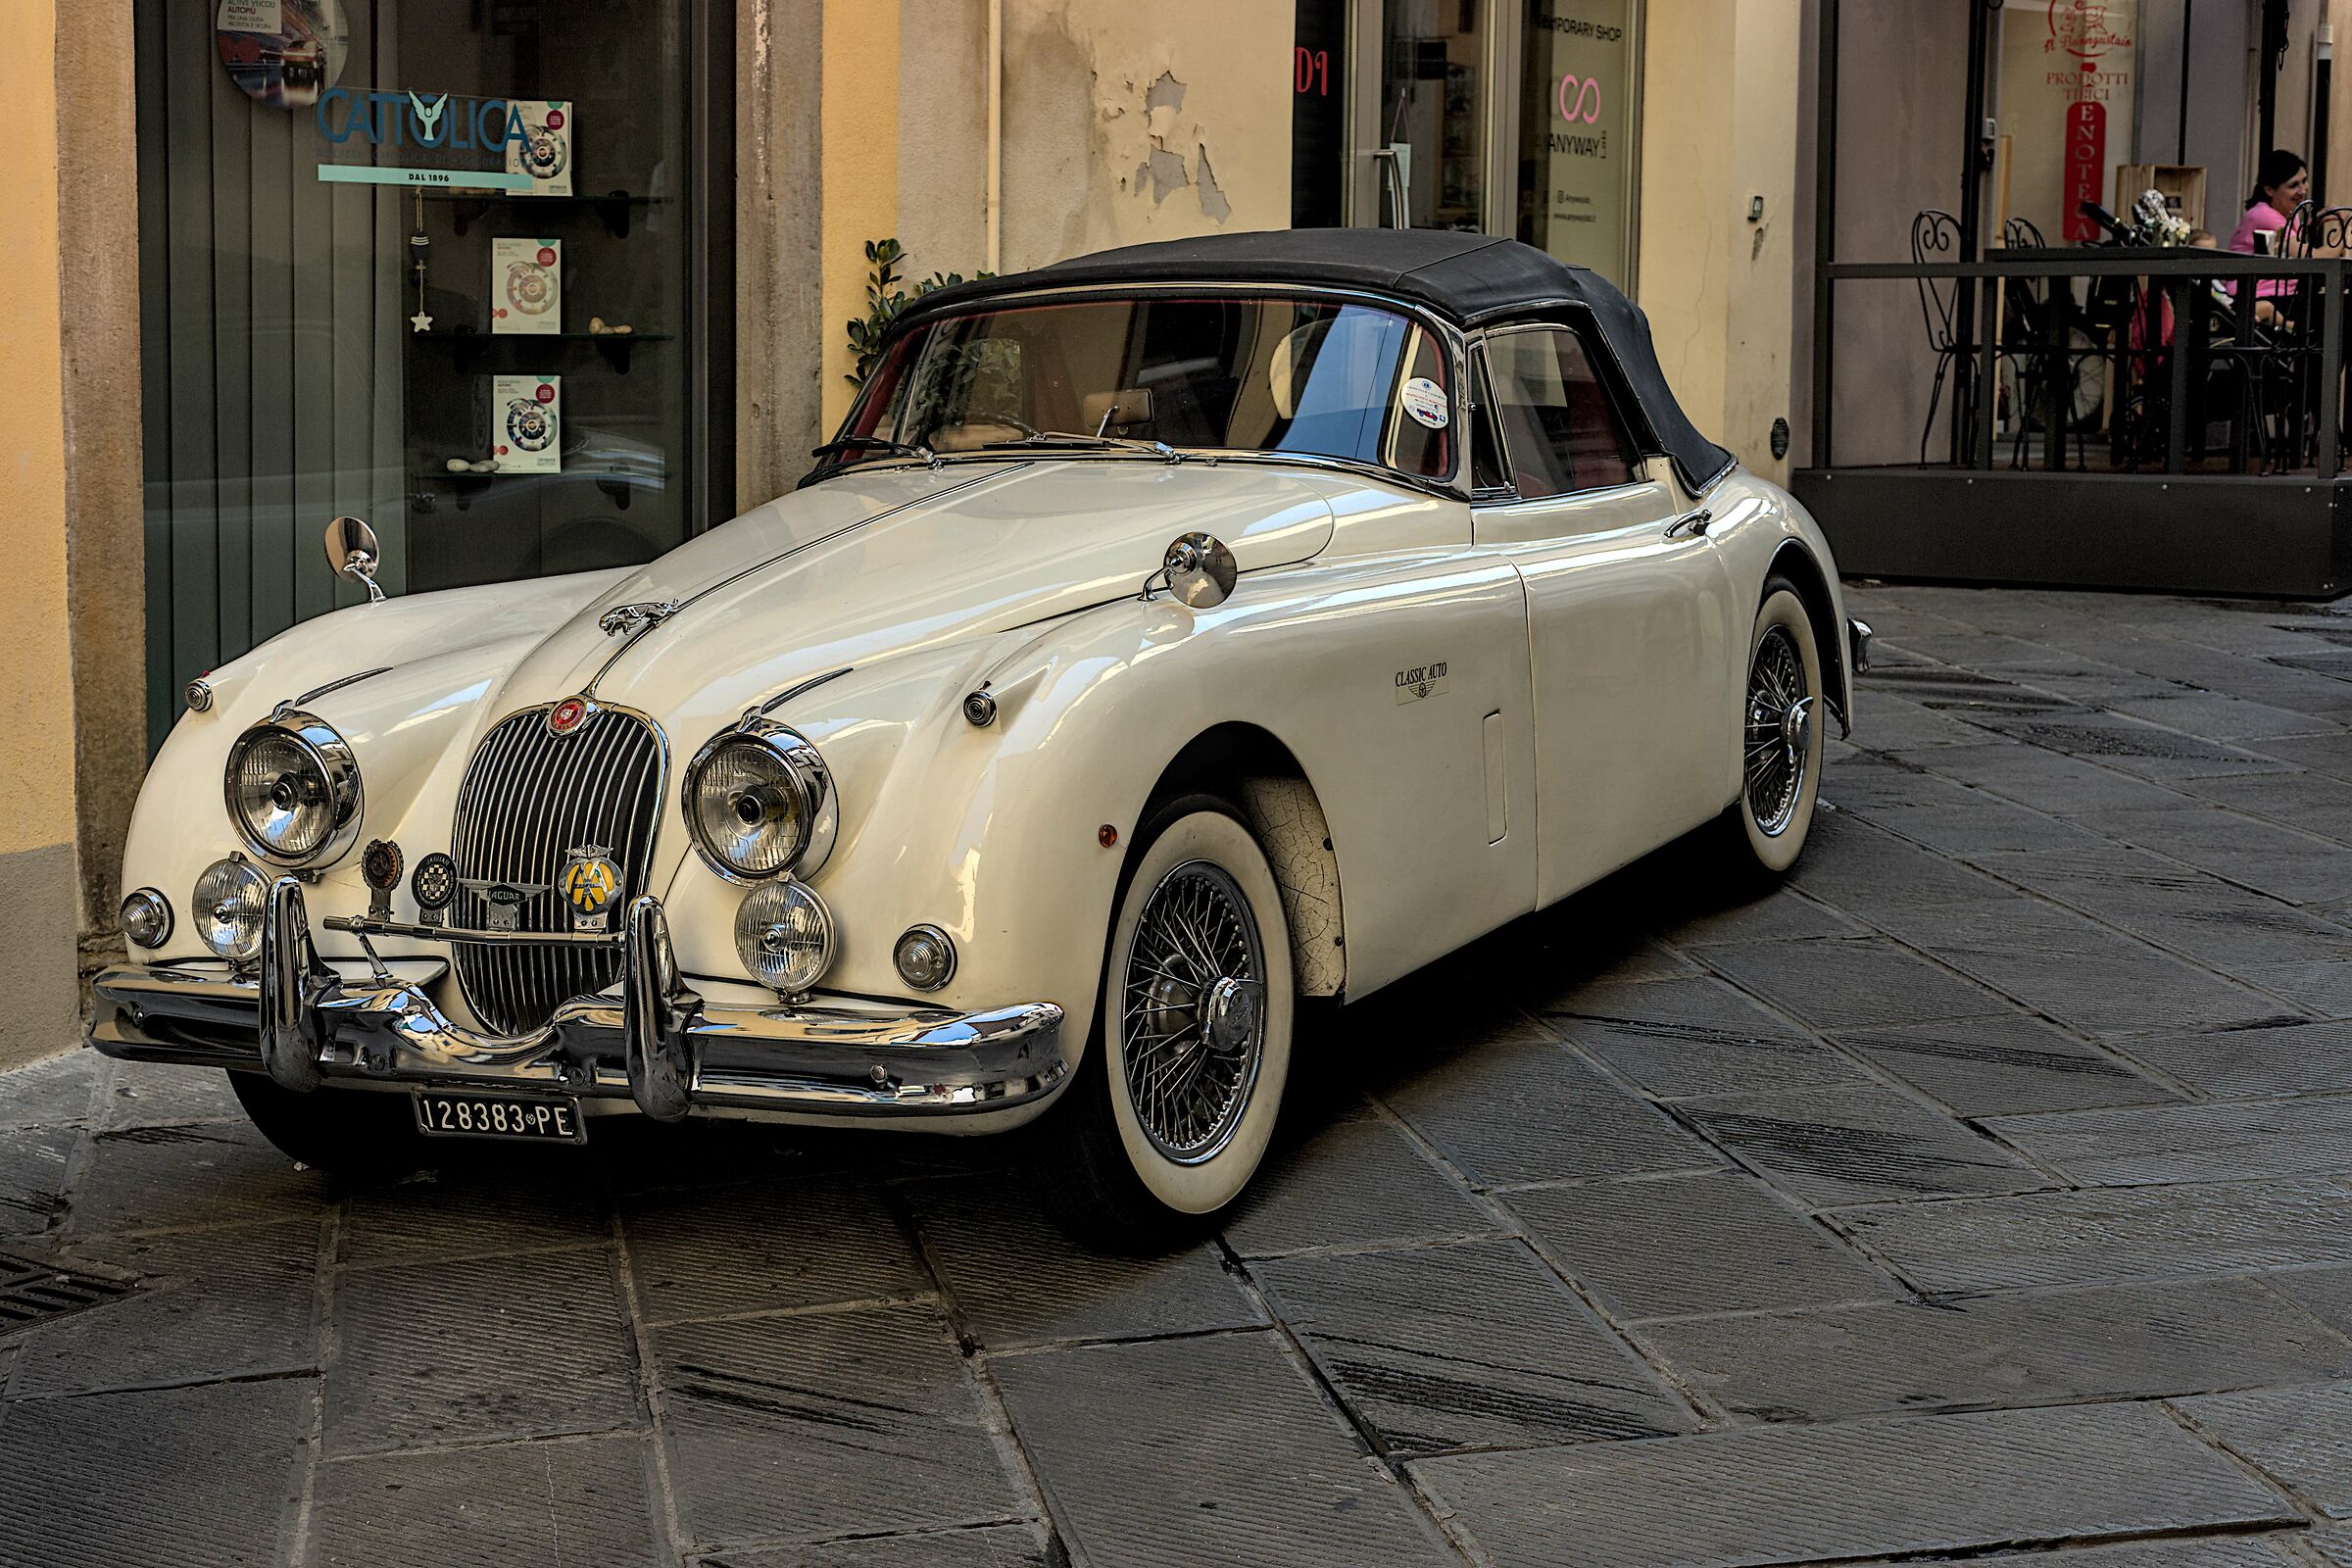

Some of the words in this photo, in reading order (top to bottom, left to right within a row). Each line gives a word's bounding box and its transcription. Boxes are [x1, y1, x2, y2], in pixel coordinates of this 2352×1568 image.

[1596, 24, 1622, 41] SHOP
[2046, 73, 2129, 85] PRODOTTI
[317, 87, 533, 154] CATTOLICA
[1548, 133, 1599, 157] ANYWAY
[409, 172, 426, 181] DAL
[428, 173, 450, 182] 1896
[1396, 666, 1427, 687] CLASSIC
[1428, 662, 1447, 680] AUTO
[426, 856, 450, 866] JAGUAR
[487, 890, 520, 901] JAGUAR
[423, 1100, 524, 1133] 128383
[535, 1106, 573, 1135] PE
